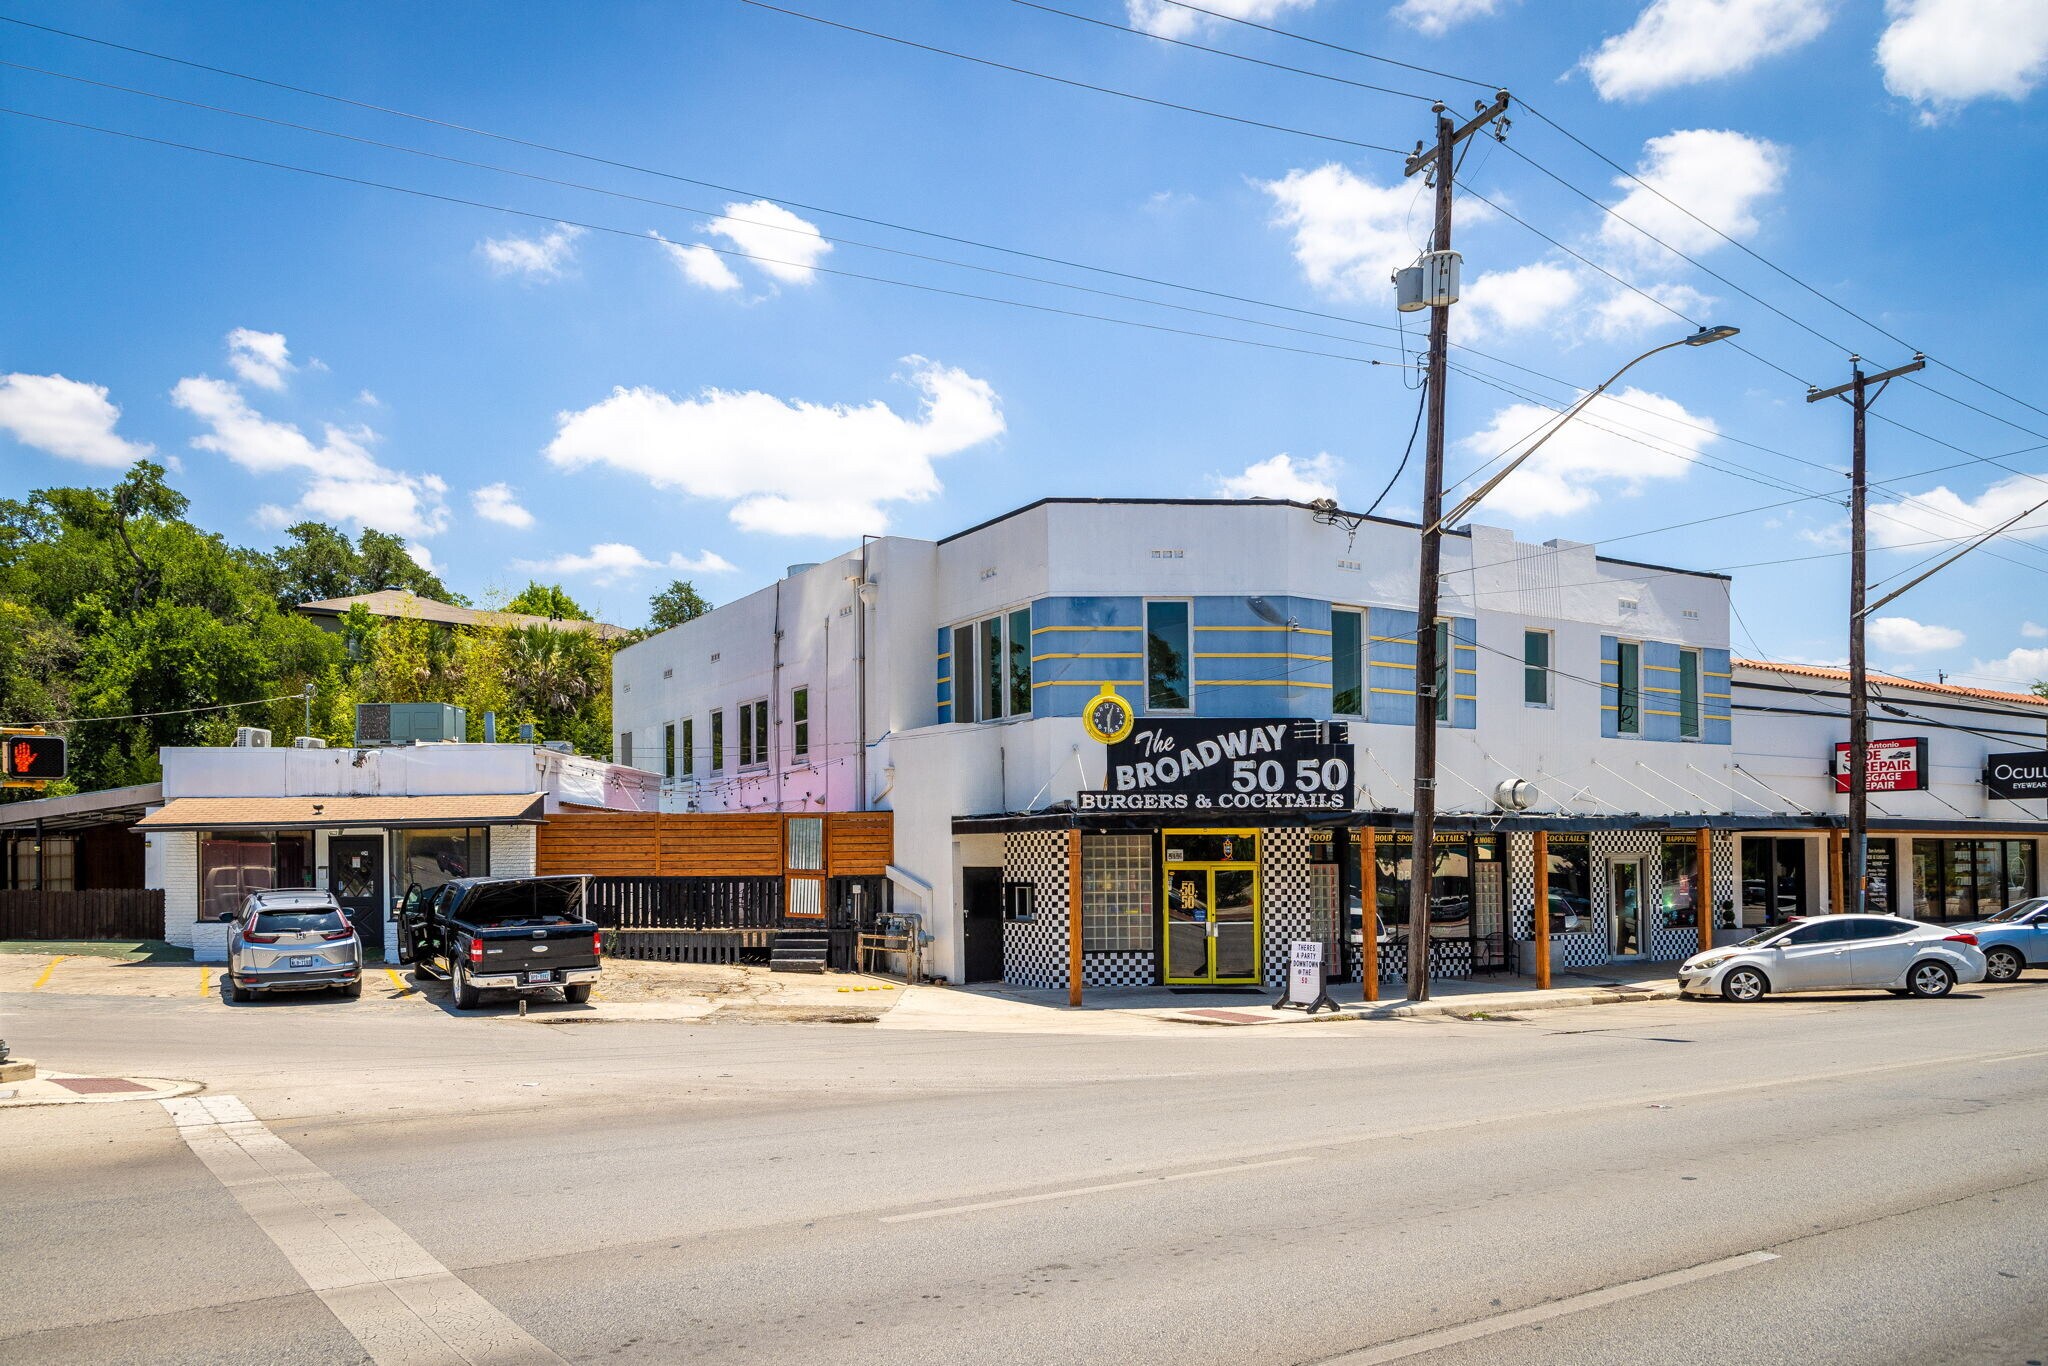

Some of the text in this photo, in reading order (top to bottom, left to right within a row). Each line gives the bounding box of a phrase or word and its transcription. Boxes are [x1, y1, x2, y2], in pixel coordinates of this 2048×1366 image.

[1134, 728, 1175, 757] The
[1869, 741, 1900, 750] Antonio
[1115, 724, 1287, 791] BROADWAY
[1845, 750, 1881, 762] SOE
[1232, 758, 1349, 793] 50 50
[1866, 772, 1902, 782] GGAGE
[1866, 782, 1895, 790] EPAIR
[1081, 793, 1344, 809] BURGERS & COCKTAILS
[1375, 834, 1393, 842] HOUR
[1665, 835, 1697, 843] HAPPY HOU
[1181, 881, 1195, 896] 50
[1181, 896, 1195, 909] 50
[1298, 944, 1316, 952] THERES
[1293, 960, 1319, 968] DOWNTOWN
[1302, 968, 1312, 976] THE
